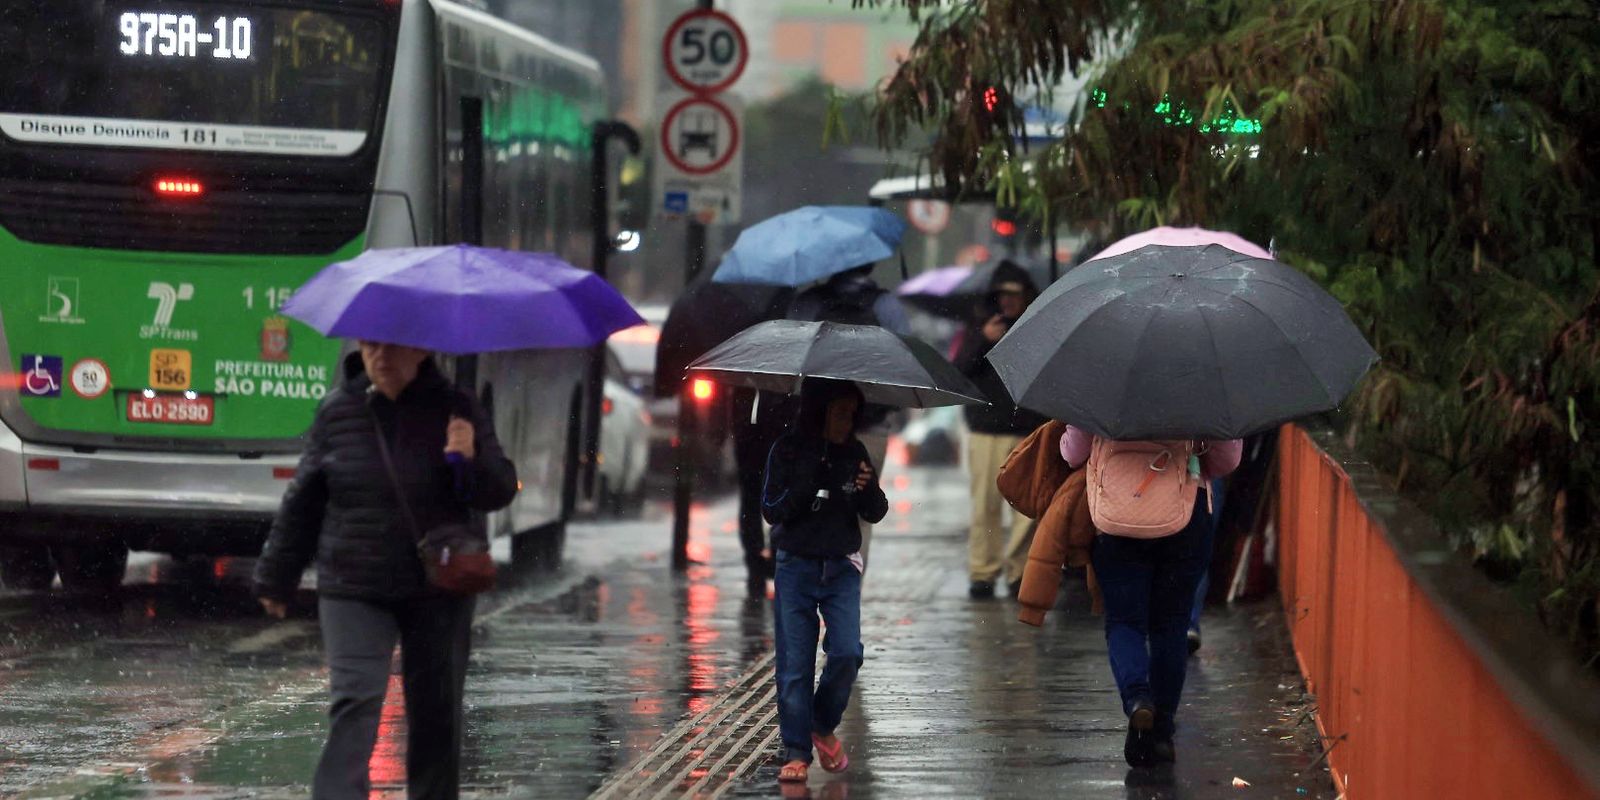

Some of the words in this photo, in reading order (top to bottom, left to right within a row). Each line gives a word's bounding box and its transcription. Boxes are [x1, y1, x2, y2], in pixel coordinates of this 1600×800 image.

[119, 12, 251, 59] 975A-10
[680, 28, 735, 65] 50
[20, 120, 86, 135] Disque
[93, 124, 170, 140] Denúncia
[181, 128, 217, 144] 181
[242, 286, 253, 310] 1
[155, 354, 178, 366] SP
[215, 360, 304, 379] PREFEITURA
[307, 365, 326, 381] DE
[82, 371, 98, 381] 50
[155, 369, 186, 385] 156
[214, 376, 255, 395] SÃO
[260, 380, 326, 400] PAULO
